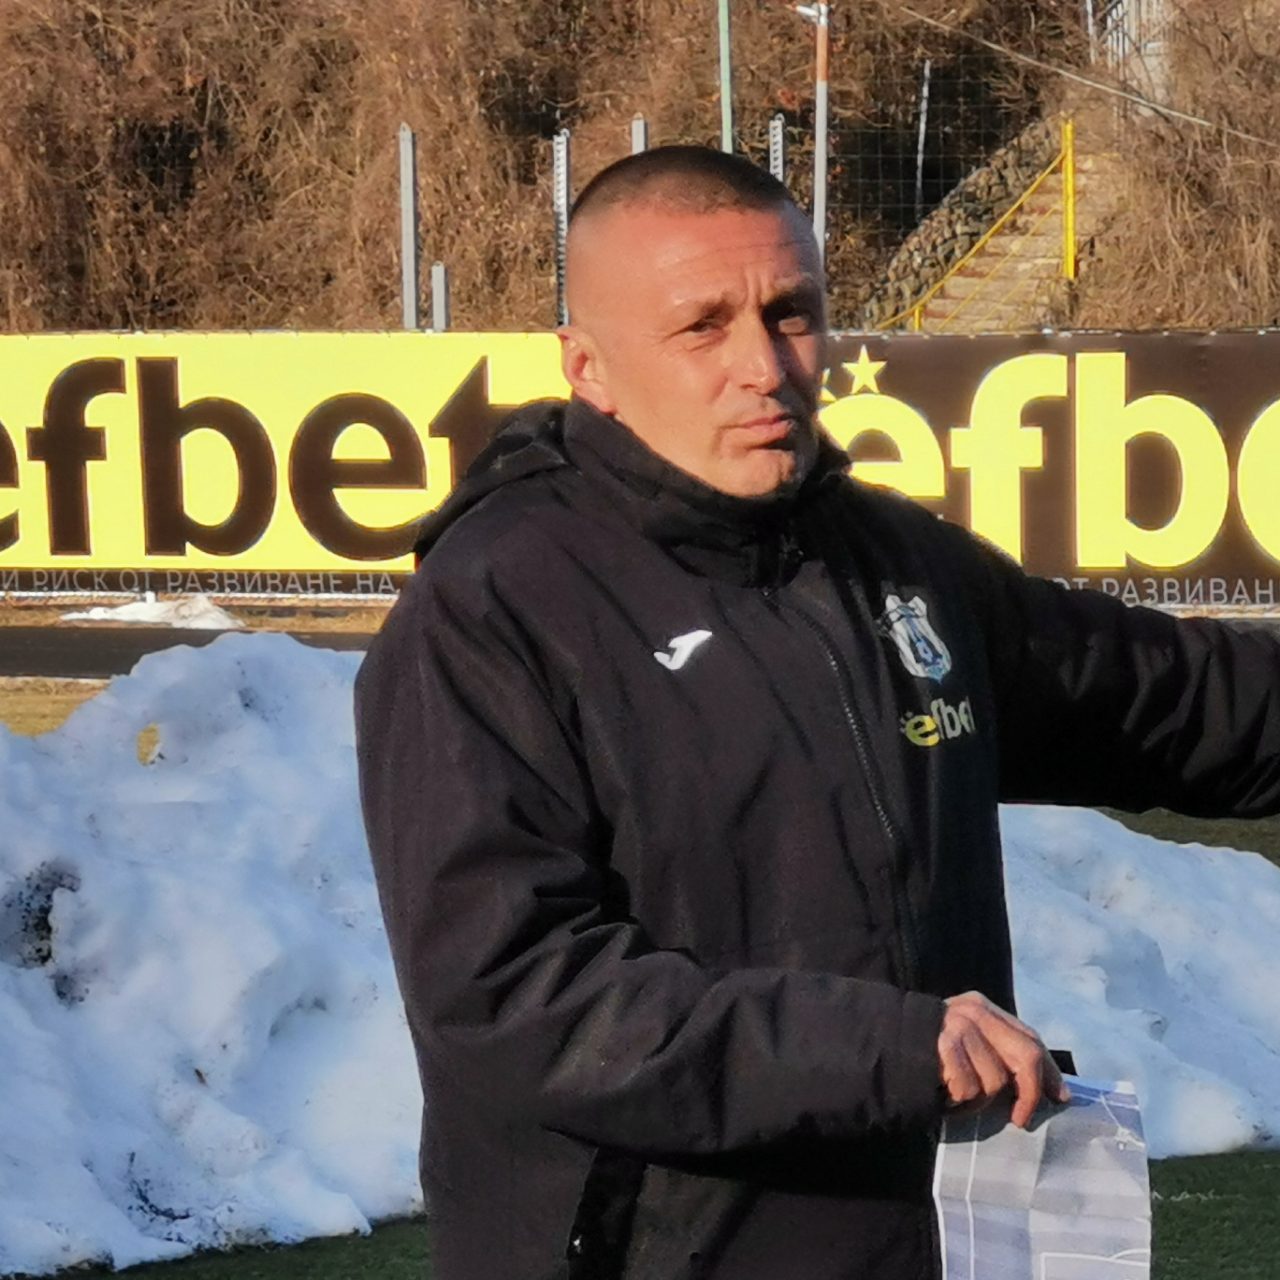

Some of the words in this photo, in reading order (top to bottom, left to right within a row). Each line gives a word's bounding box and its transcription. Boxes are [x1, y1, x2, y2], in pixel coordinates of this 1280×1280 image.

[32, 569, 109, 591] РИСК
[119, 570, 154, 592] ОТ
[166, 570, 344, 593] РАЗВИВАНЕ
[355, 572, 398, 594] НА
